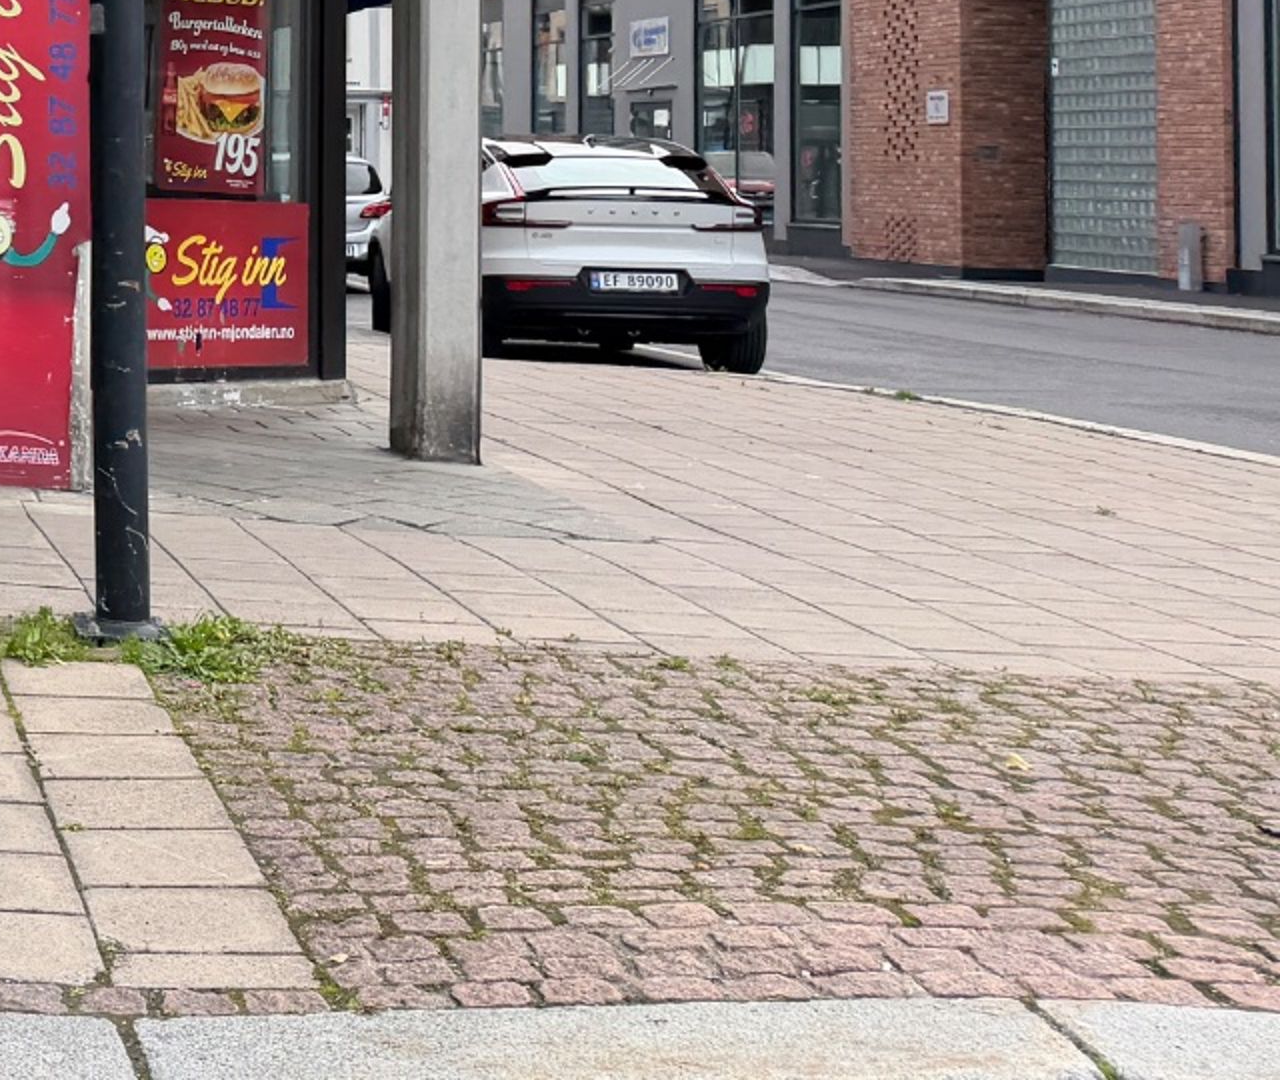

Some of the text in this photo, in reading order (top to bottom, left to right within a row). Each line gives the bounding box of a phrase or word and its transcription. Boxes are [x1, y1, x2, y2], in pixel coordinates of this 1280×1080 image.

[48, 42, 77, 81] 48
[48, 95, 77, 137] 87
[47, 151, 77, 190] 32
[214, 132, 261, 177] 195
[171, 234, 287, 305] Stig inn
[603, 273, 674, 289] EF 89090
[173, 298, 192, 318] 32
[197, 298, 213, 317] 87
[244, 298, 261, 317] 77
